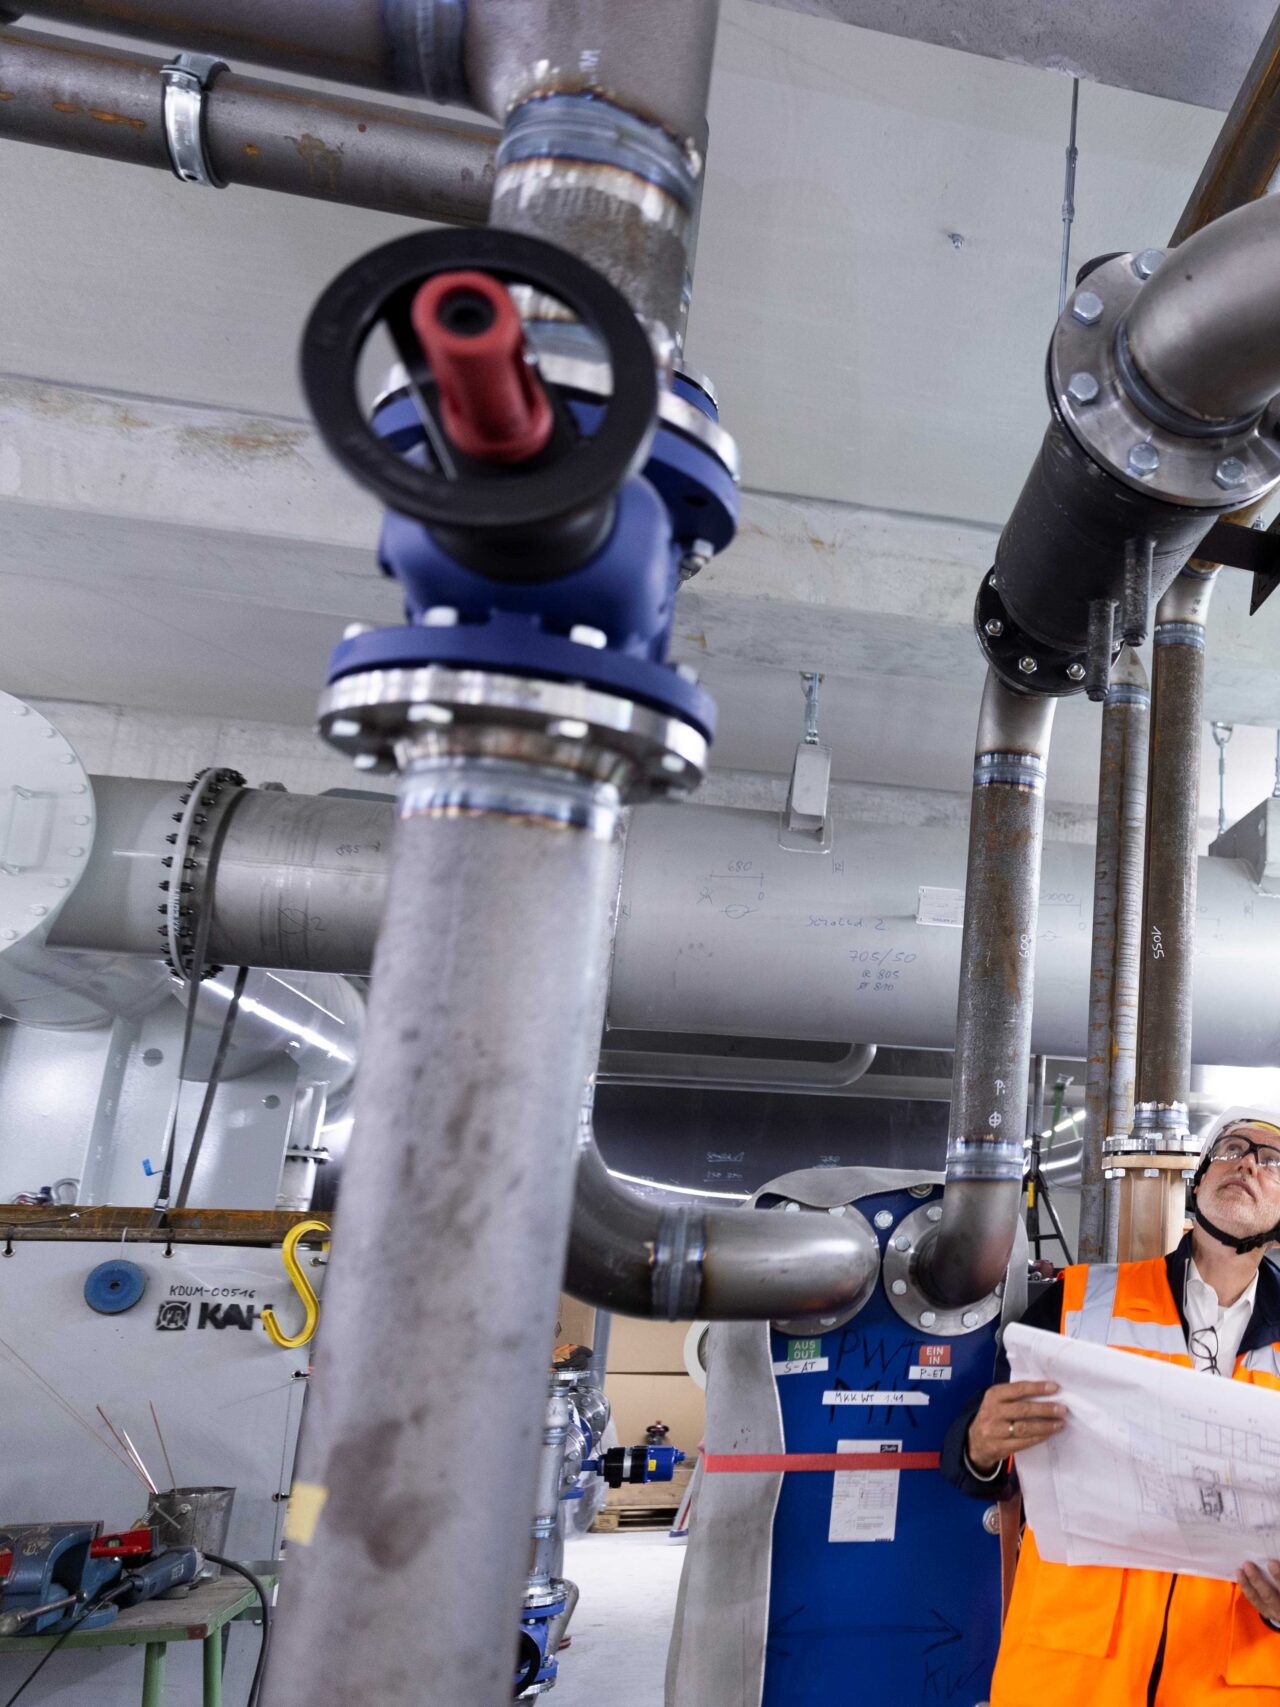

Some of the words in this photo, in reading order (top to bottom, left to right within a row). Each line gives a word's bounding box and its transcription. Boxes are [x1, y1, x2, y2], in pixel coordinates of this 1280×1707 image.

[793, 1341, 816, 1350] AUS
[793, 1350, 815, 1359] OUT
[926, 1346, 944, 1356] EIN
[928, 1356, 940, 1365] IN
